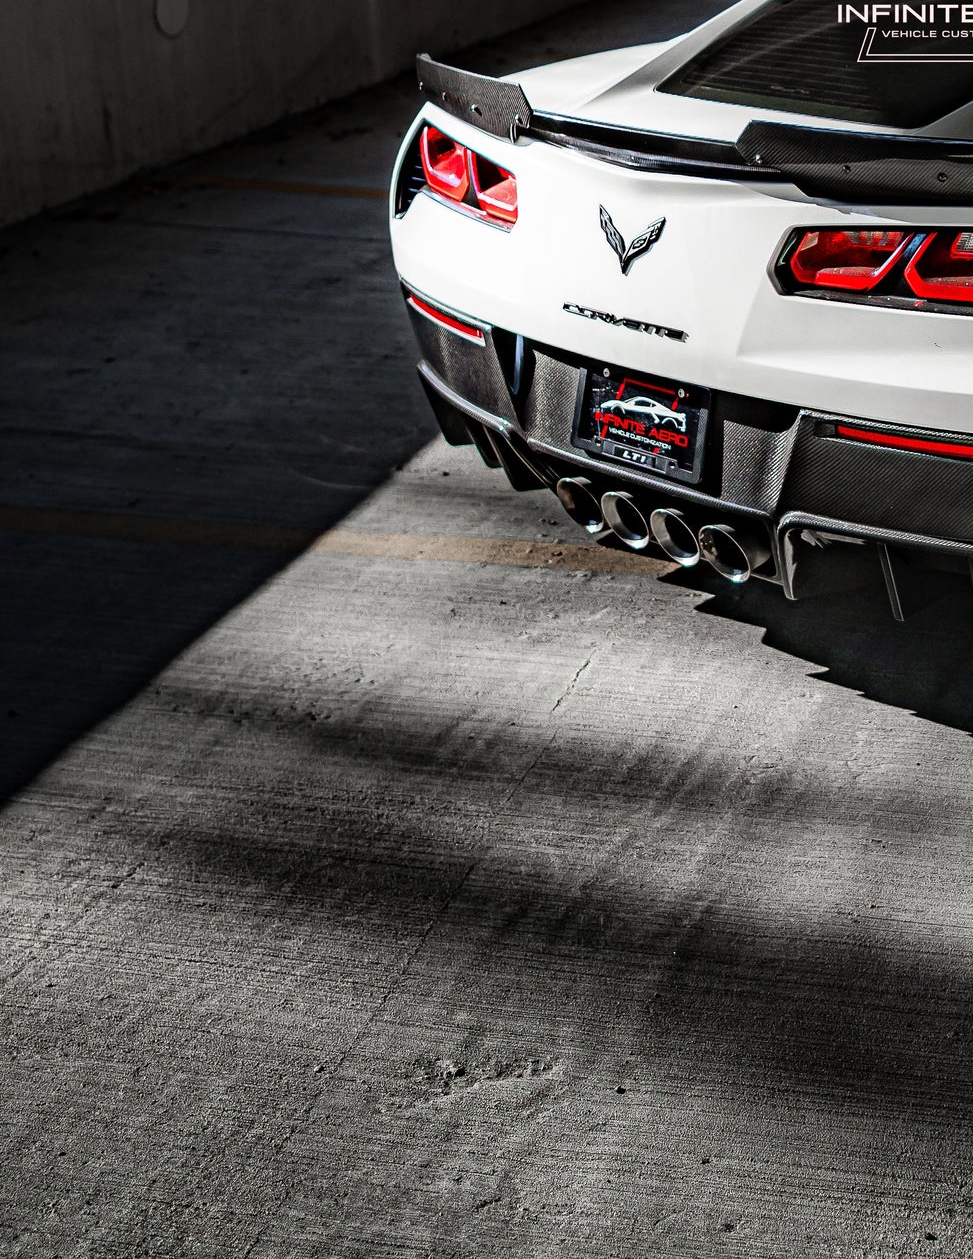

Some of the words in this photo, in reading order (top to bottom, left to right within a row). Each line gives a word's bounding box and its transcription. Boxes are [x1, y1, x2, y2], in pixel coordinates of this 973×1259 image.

[562, 301, 690, 343] CORVETTE
[608, 426, 631, 439] VEHICLE
[648, 426, 689, 448] AERO
